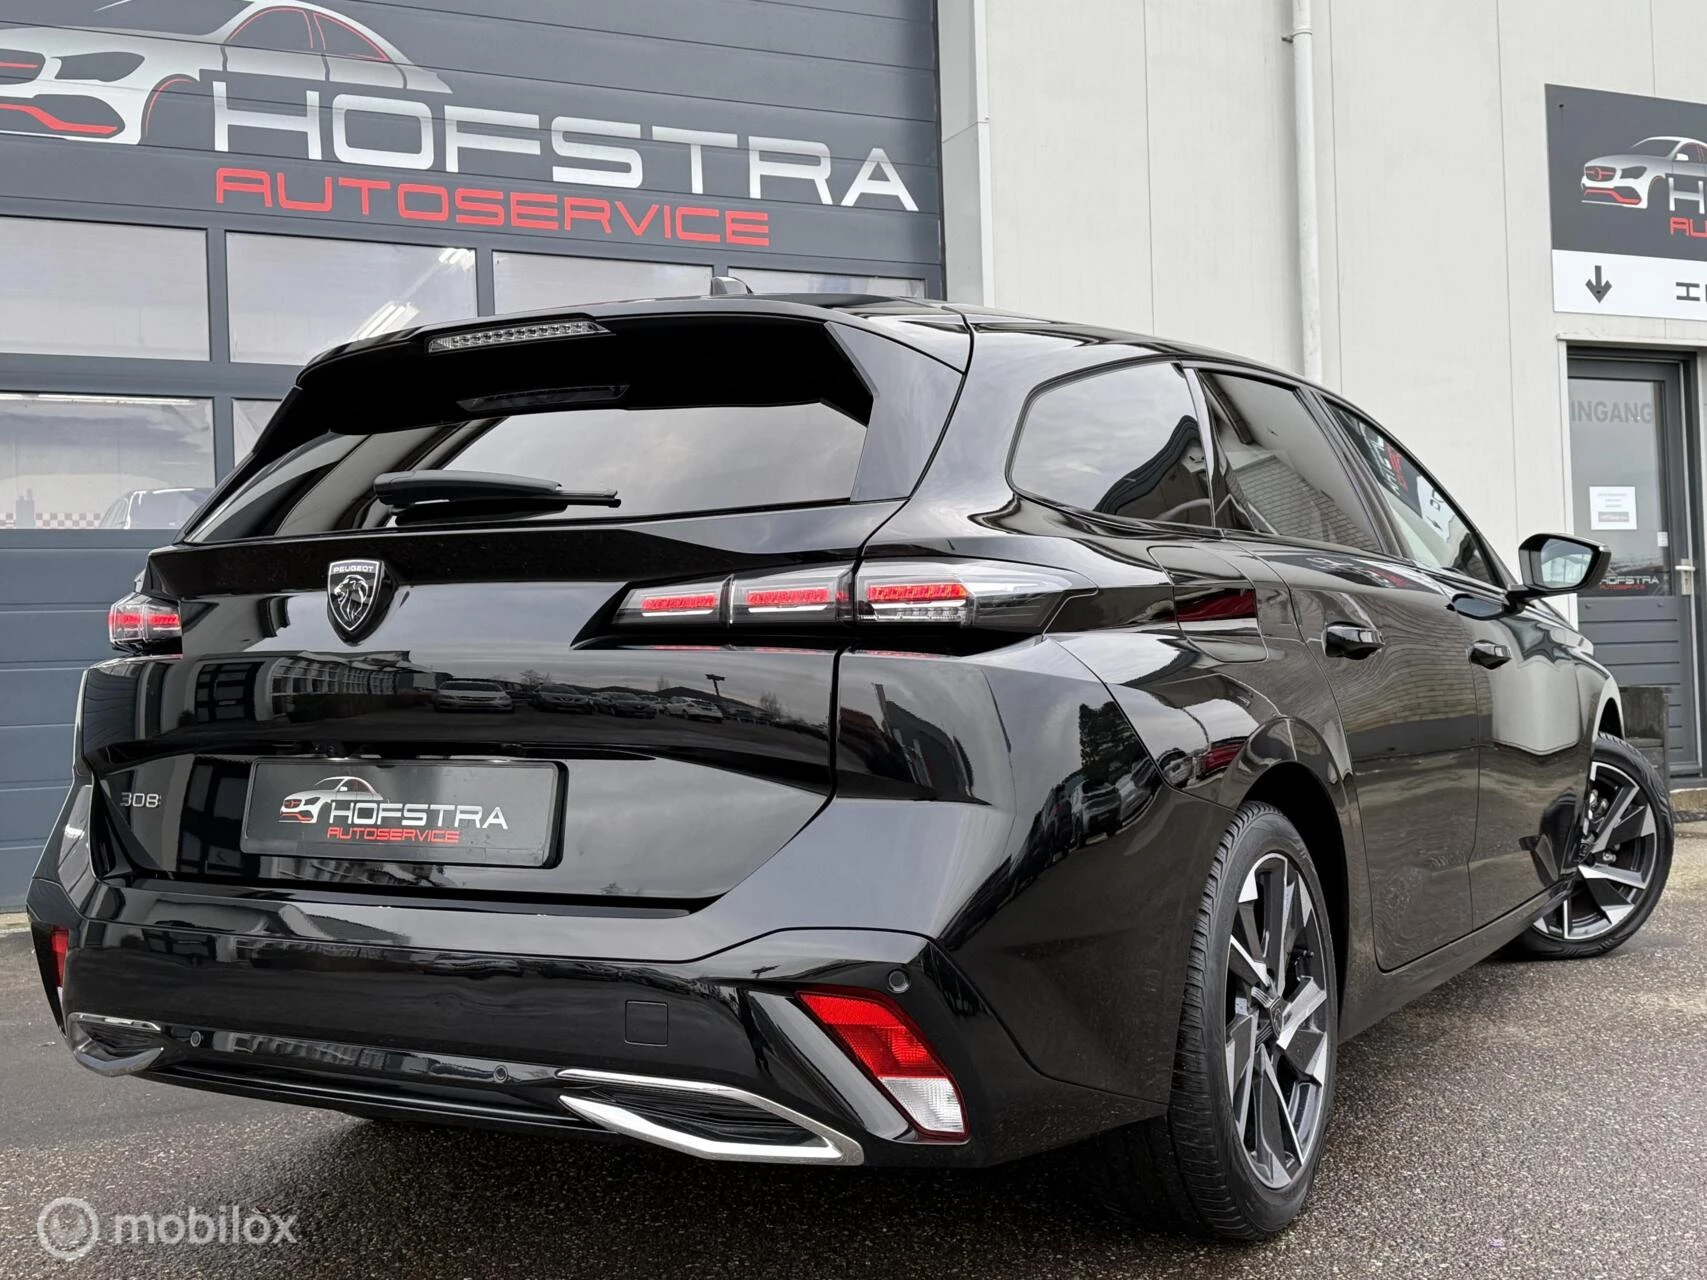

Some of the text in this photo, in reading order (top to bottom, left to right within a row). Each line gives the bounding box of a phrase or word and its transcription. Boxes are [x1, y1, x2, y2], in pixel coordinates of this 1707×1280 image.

[213, 81, 919, 212] HOFSTRA
[215, 168, 770, 247] AUTOSERVICE
[1570, 400, 1653, 424] INGANG
[120, 792, 161, 808] 308
[329, 802, 508, 829] HOFSTRA
[327, 827, 460, 843] AUTOSERVICE
